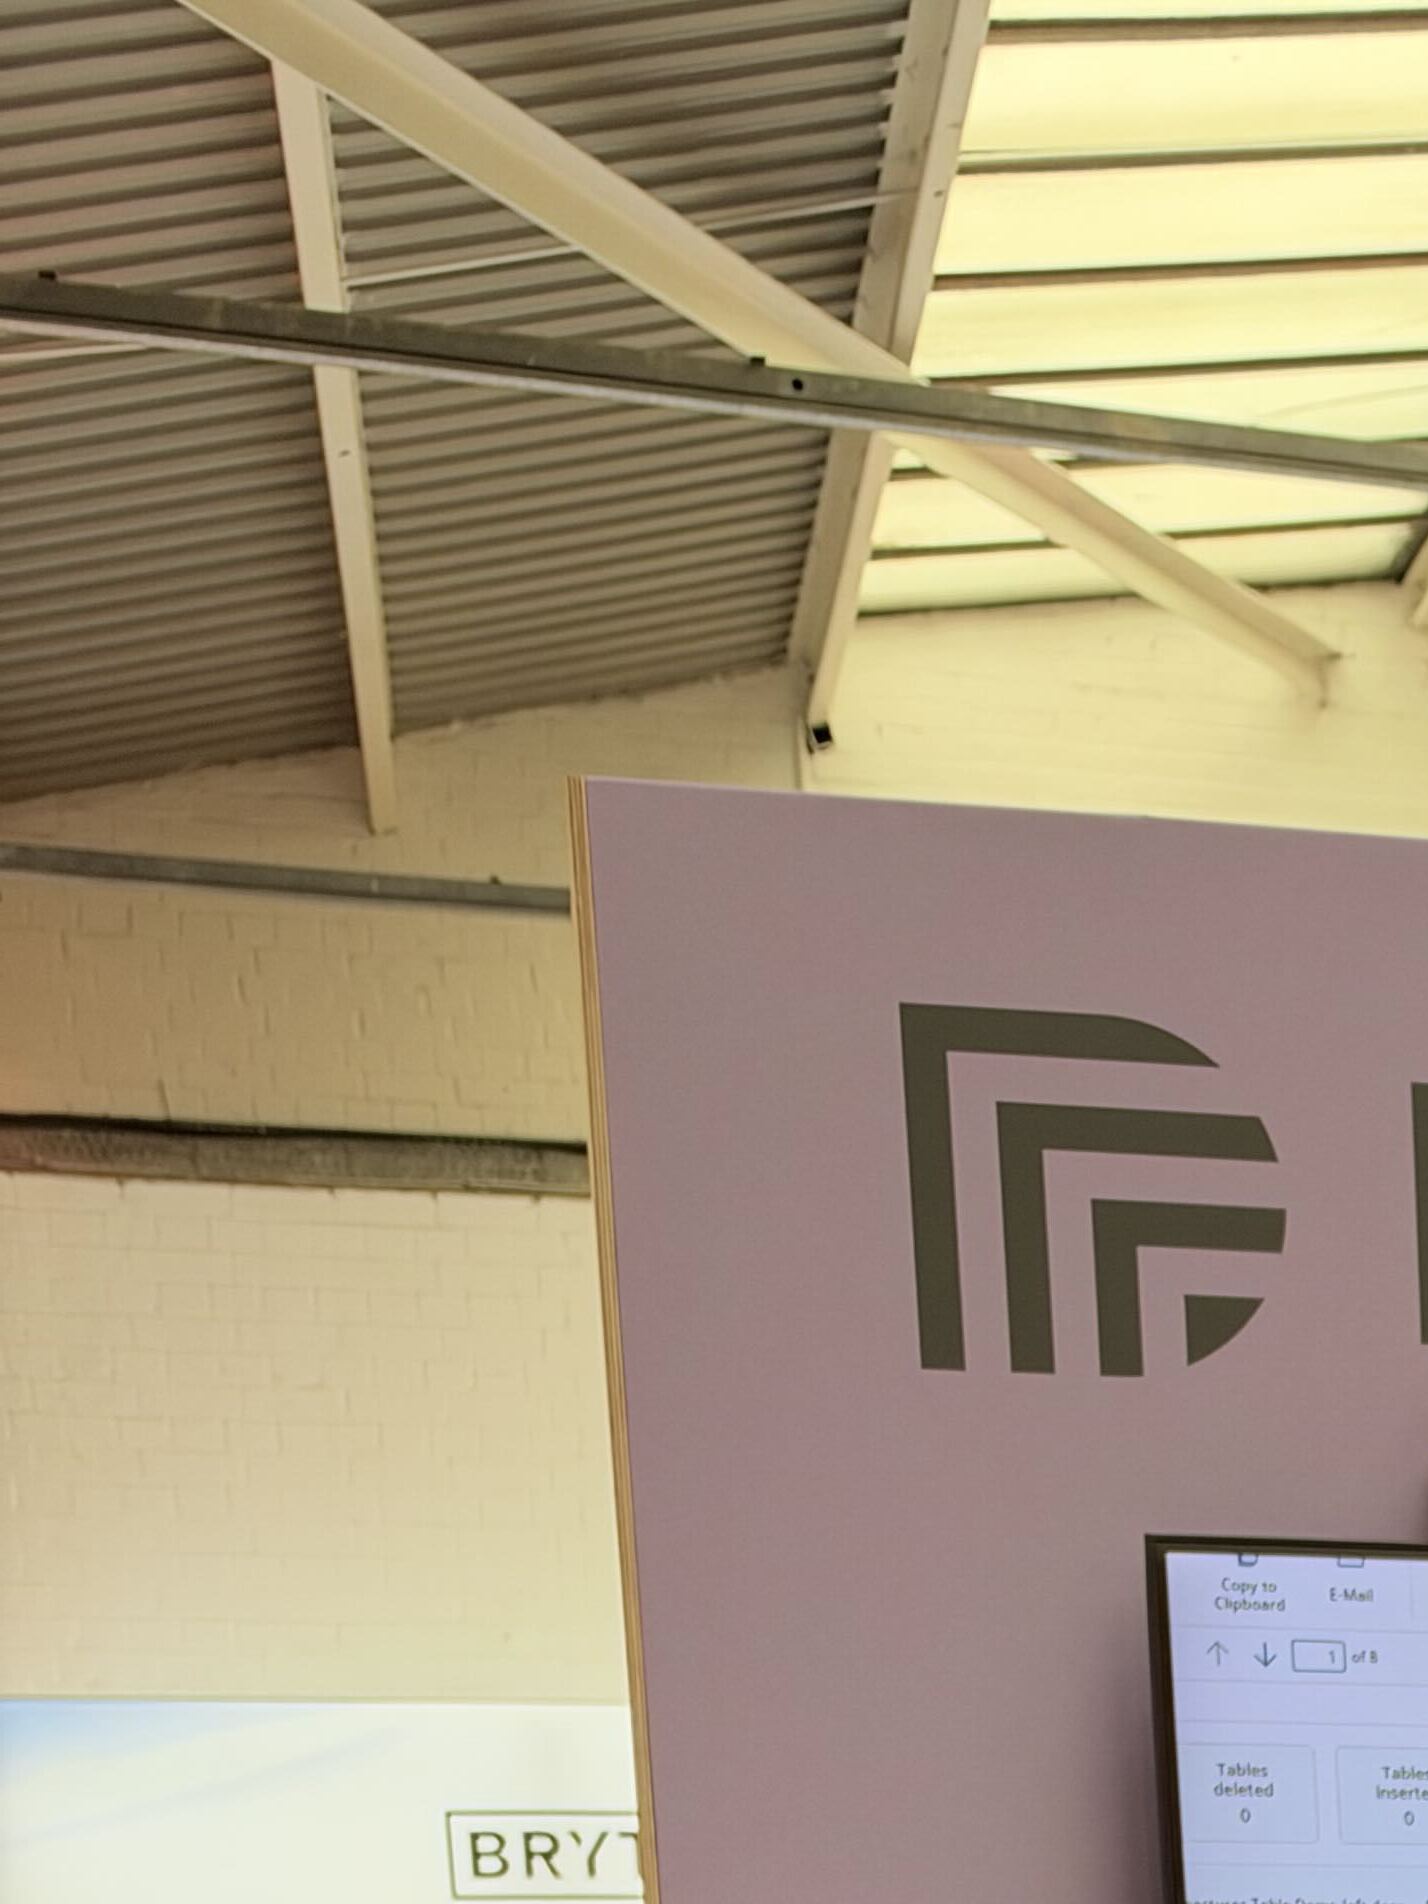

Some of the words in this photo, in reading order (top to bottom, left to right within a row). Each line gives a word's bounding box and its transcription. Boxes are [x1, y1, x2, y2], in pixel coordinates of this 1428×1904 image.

[1221, 1577, 1258, 1594] Copy
[1262, 1580, 1277, 1594] to
[1329, 1587, 1374, 1602] E-Mail
[1214, 1595, 1286, 1613] Clipboard
[1329, 1651, 1335, 1664] 1
[1351, 1650, 1366, 1664] of
[1217, 1762, 1268, 1778] Tables
[1213, 1783, 1274, 1799] deleted
[1240, 1809, 1251, 1824] 0
[1404, 1811, 1415, 1827] 0
